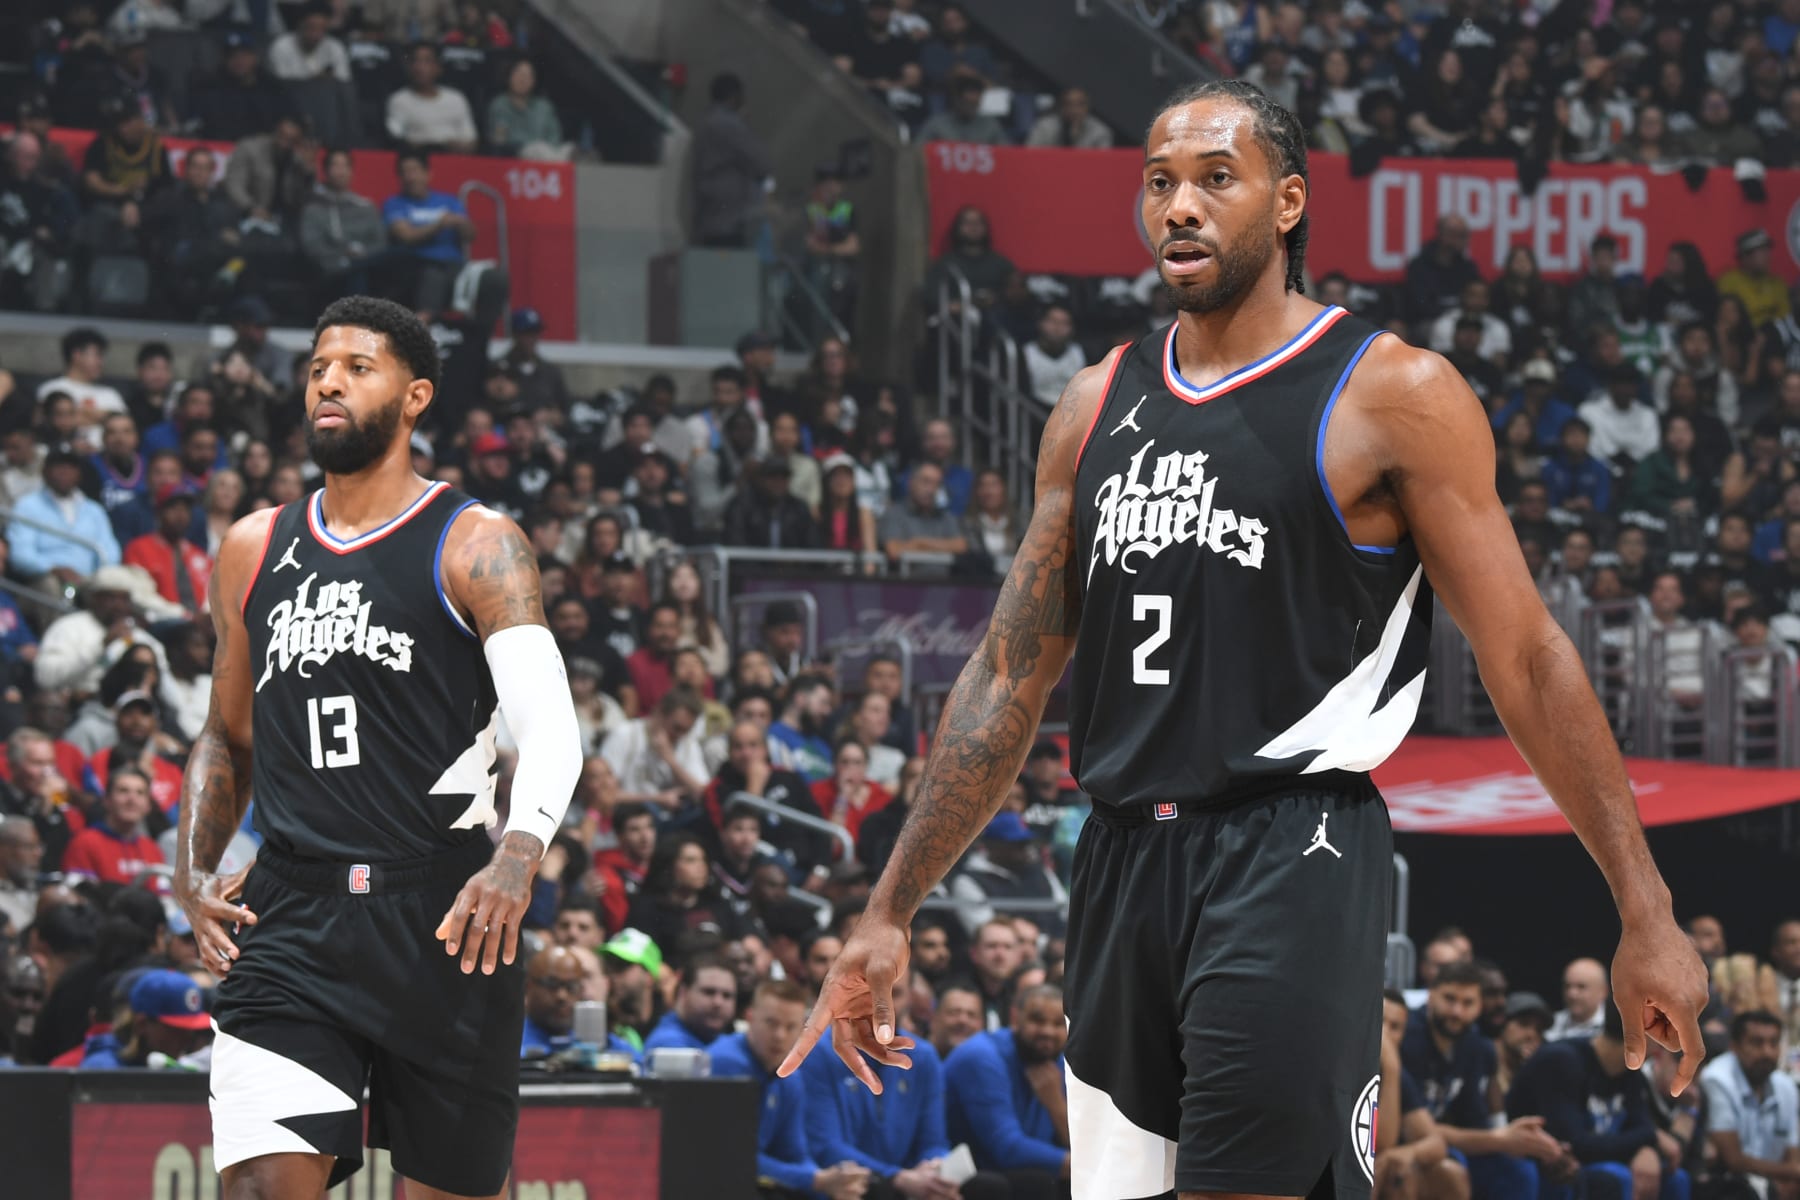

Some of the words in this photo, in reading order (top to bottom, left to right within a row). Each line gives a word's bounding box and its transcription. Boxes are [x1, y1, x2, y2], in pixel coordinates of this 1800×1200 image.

[506, 169, 562, 200] 104
[937, 144, 994, 174] 105
[1118, 439, 1209, 500] Los
[1087, 474, 1269, 591] Angeles
[290, 572, 363, 622] Los
[256, 600, 415, 693] Angeles
[1132, 594, 1173, 686] 2
[307, 694, 361, 769] 13
